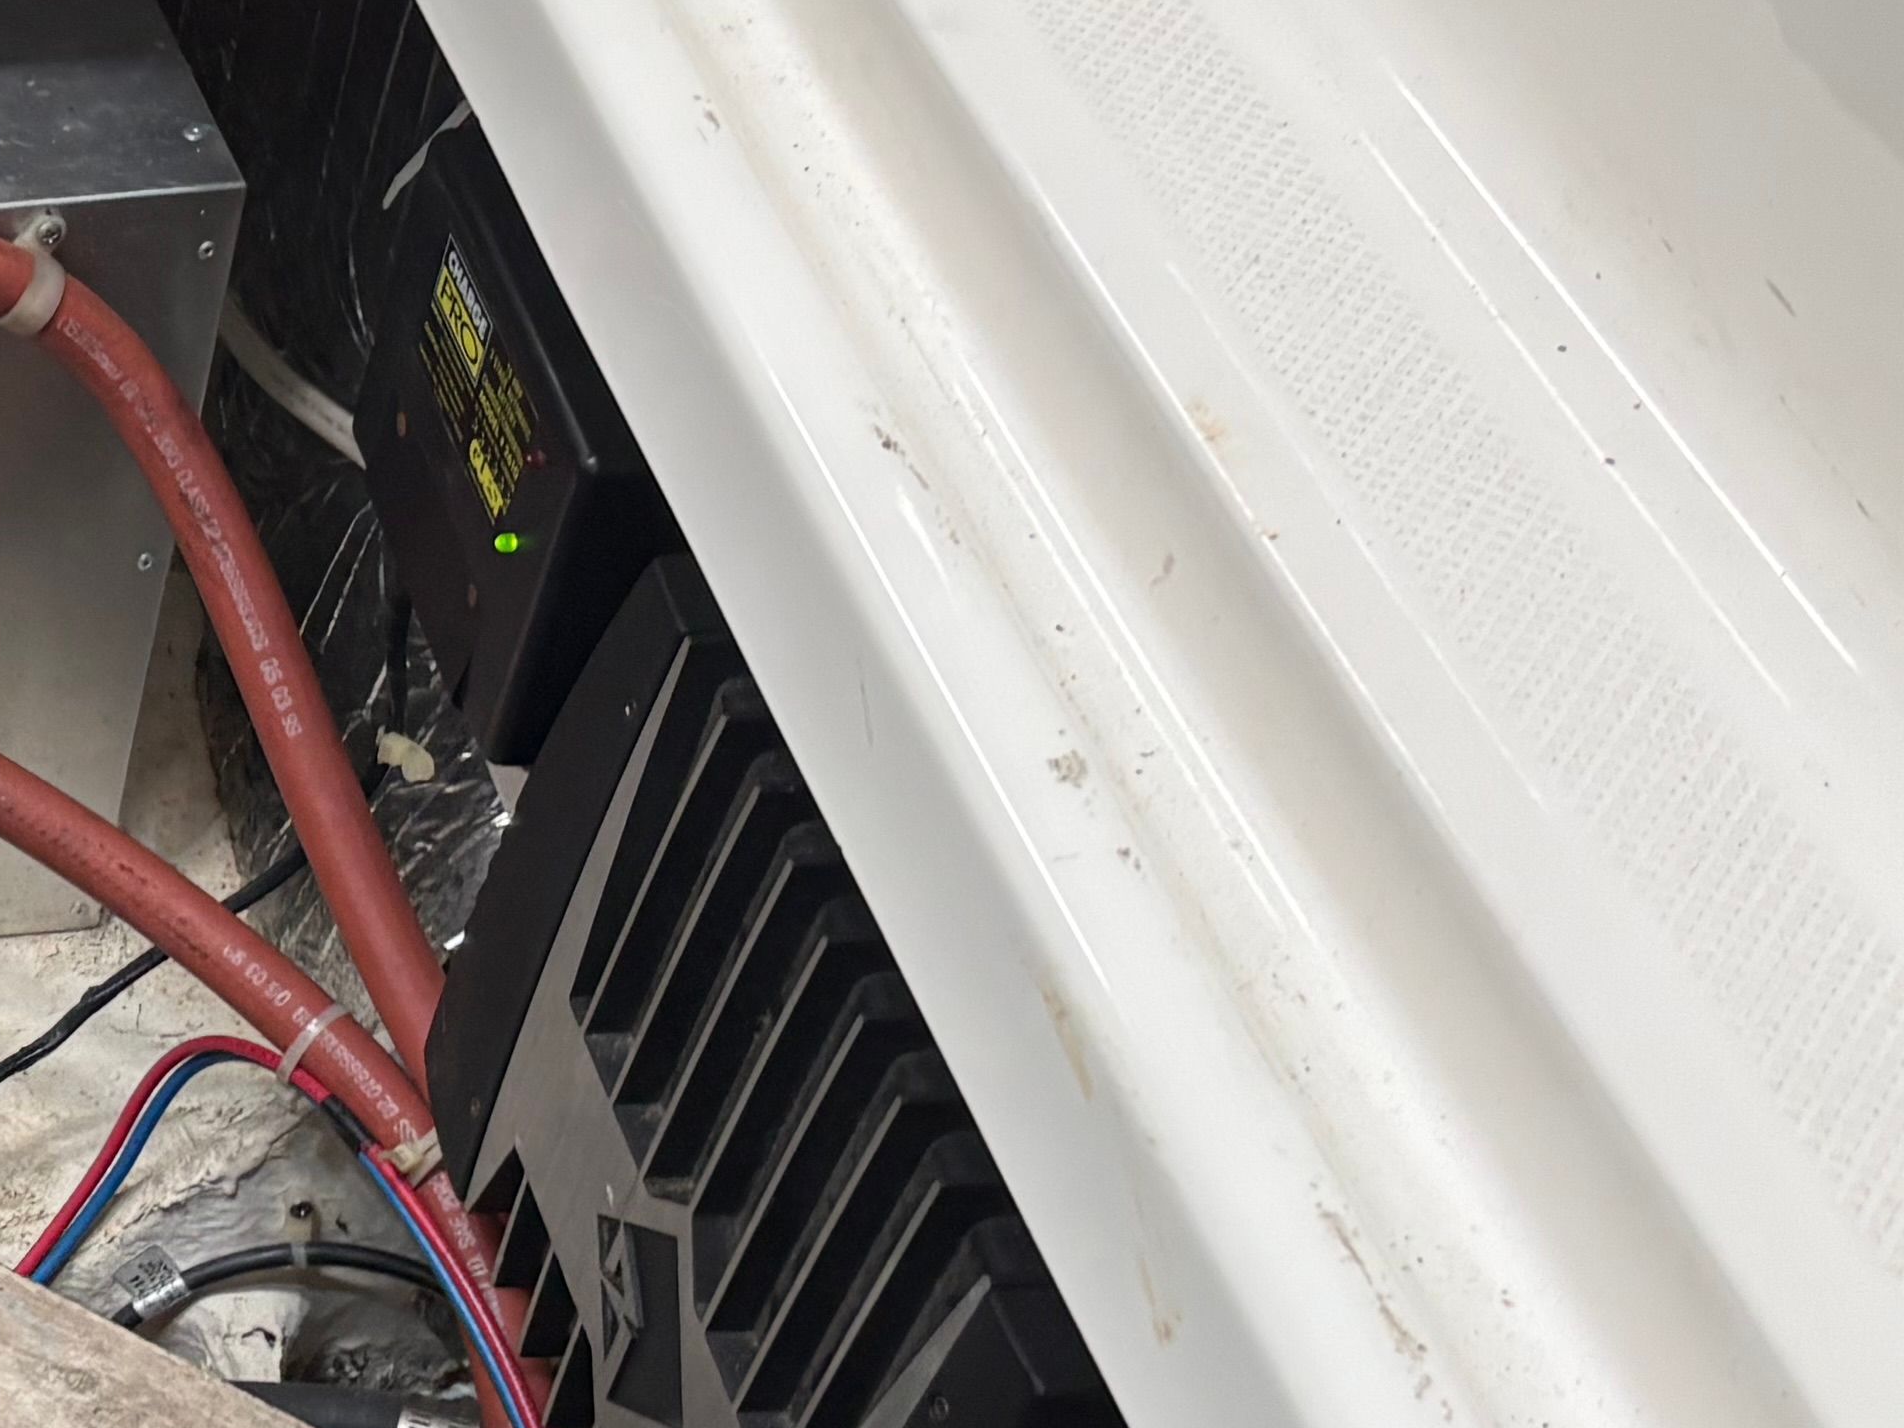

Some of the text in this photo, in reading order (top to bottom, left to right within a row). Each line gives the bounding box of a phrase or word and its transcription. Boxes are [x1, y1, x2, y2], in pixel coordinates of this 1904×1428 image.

[439, 274, 480, 372] PRO
[446, 245, 488, 344] CHARGE
[445, 1212, 478, 1252] SAE
